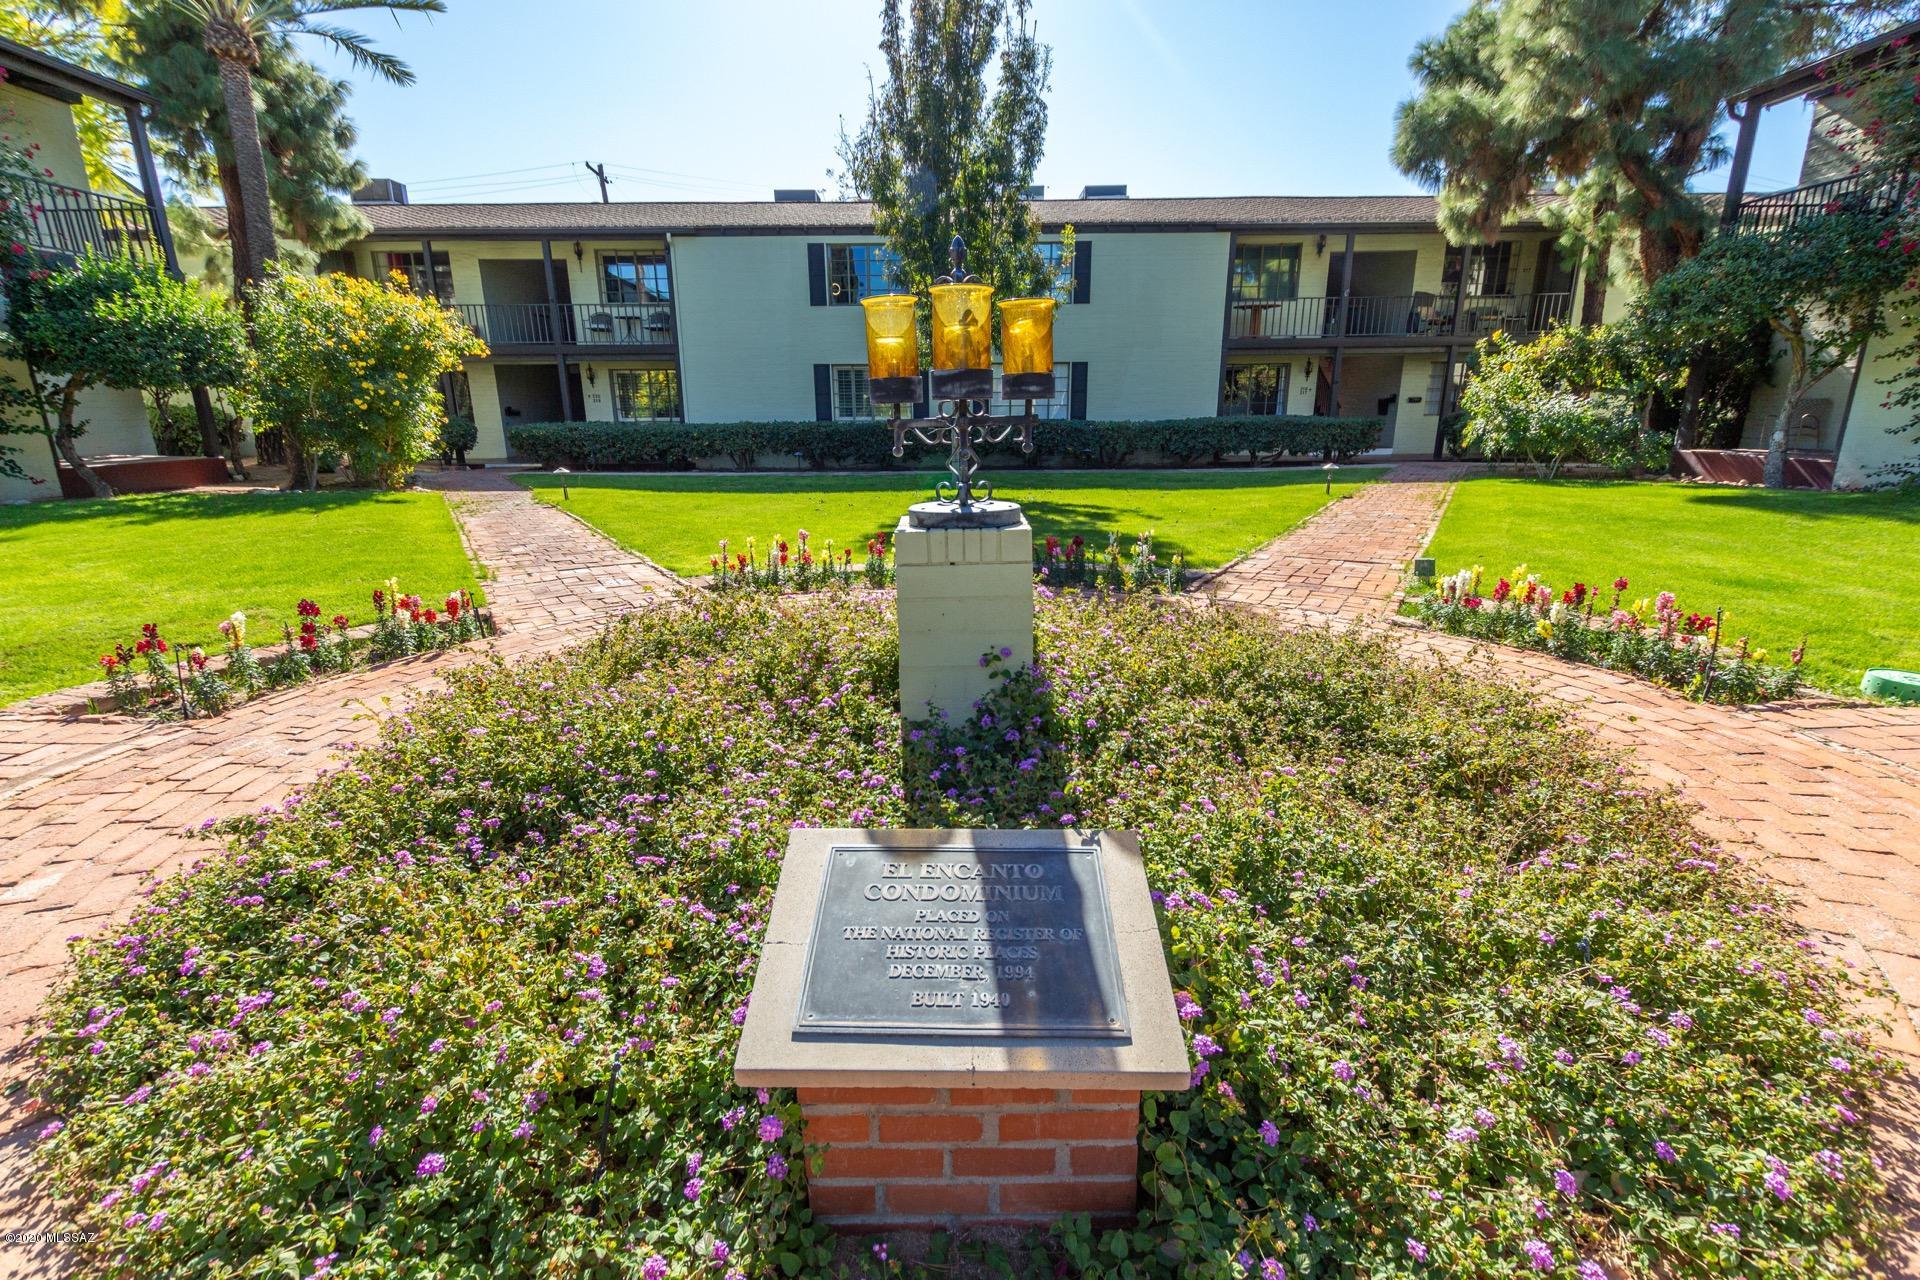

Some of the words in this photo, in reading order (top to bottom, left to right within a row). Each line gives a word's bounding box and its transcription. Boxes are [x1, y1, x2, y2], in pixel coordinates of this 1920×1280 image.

[882, 863, 912, 880] EL
[920, 863, 1044, 880] ENCANTO
[864, 884, 1064, 902] CONDOMINIUM
[915, 909, 981, 923] PLACED
[985, 909, 1010, 923] ON
[843, 926, 877, 941] THE
[881, 926, 969, 941] NATIONAL
[974, 927, 1055, 942] REGISTER
[1059, 928, 1084, 942] OF
[886, 945, 969, 960] HISTORIC
[973, 945, 1040, 960] PLACES
[889, 964, 989, 982] DECEMBER,
[996, 965, 1034, 981] 1994
[911, 991, 965, 1008] BUILT
[970, 991, 1011, 1008] 1940
